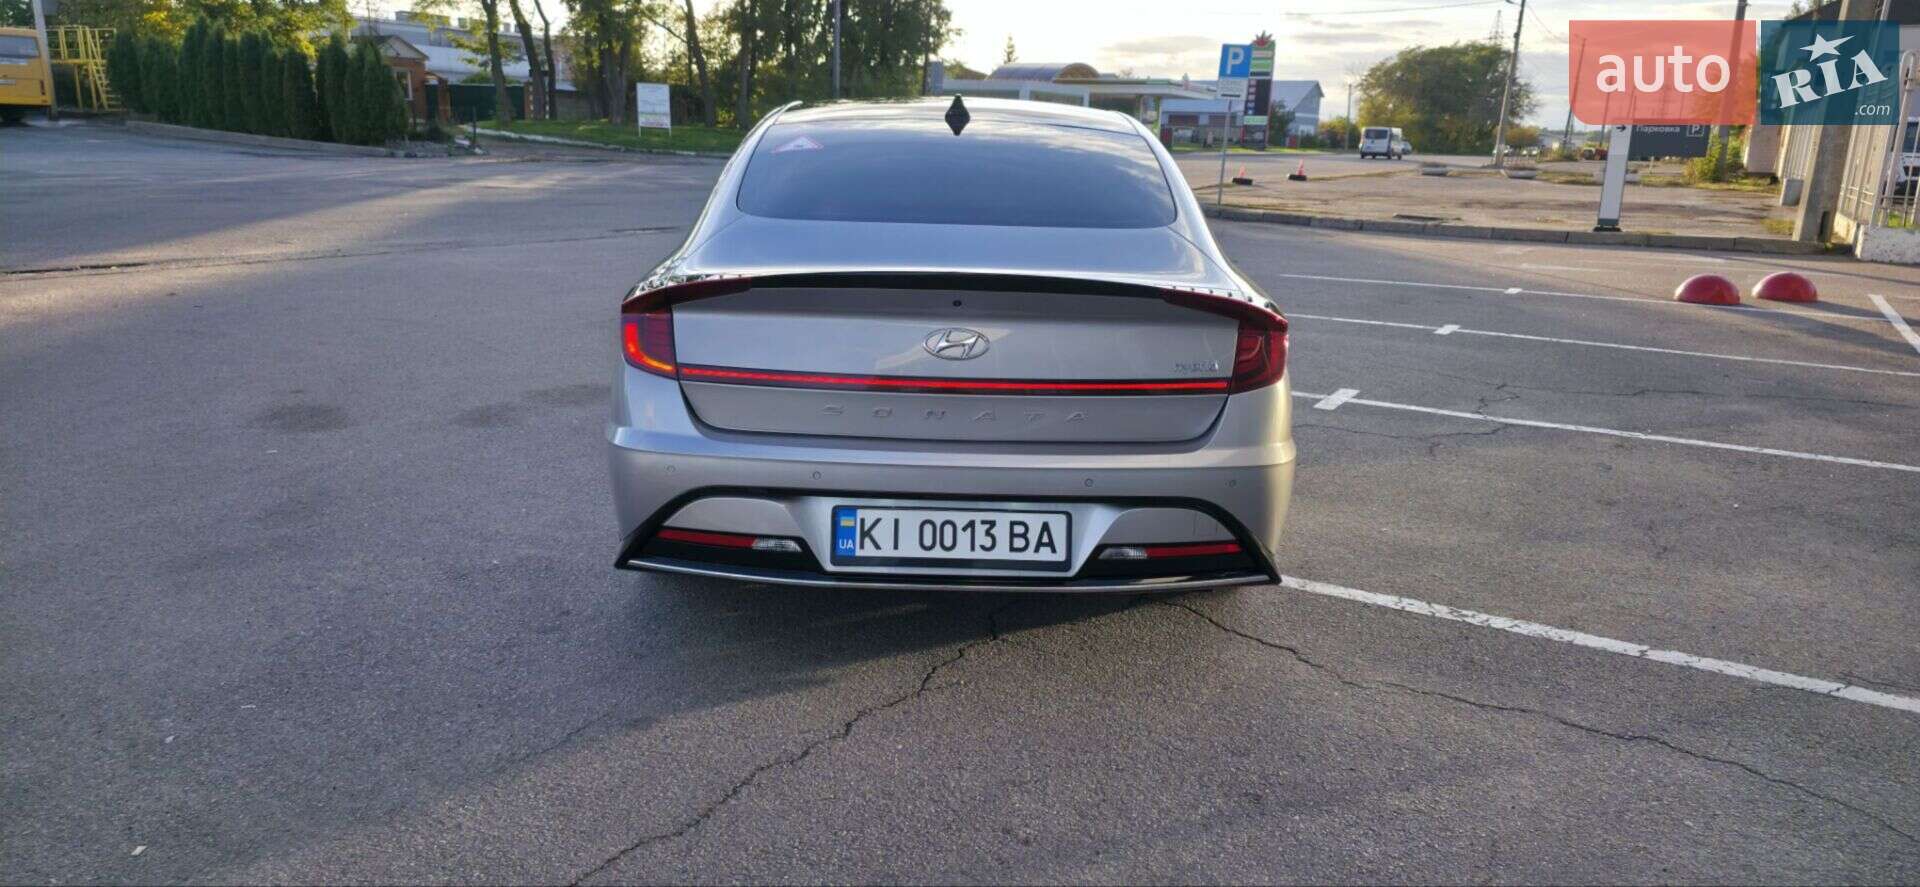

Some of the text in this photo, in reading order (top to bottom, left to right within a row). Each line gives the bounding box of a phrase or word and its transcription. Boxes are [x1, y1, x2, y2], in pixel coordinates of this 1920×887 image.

[1226, 47, 1245, 75] P
[822, 404, 1089, 424] SONATA
[839, 540, 854, 550] UA
[859, 518, 1057, 554] KI 0013 BA
